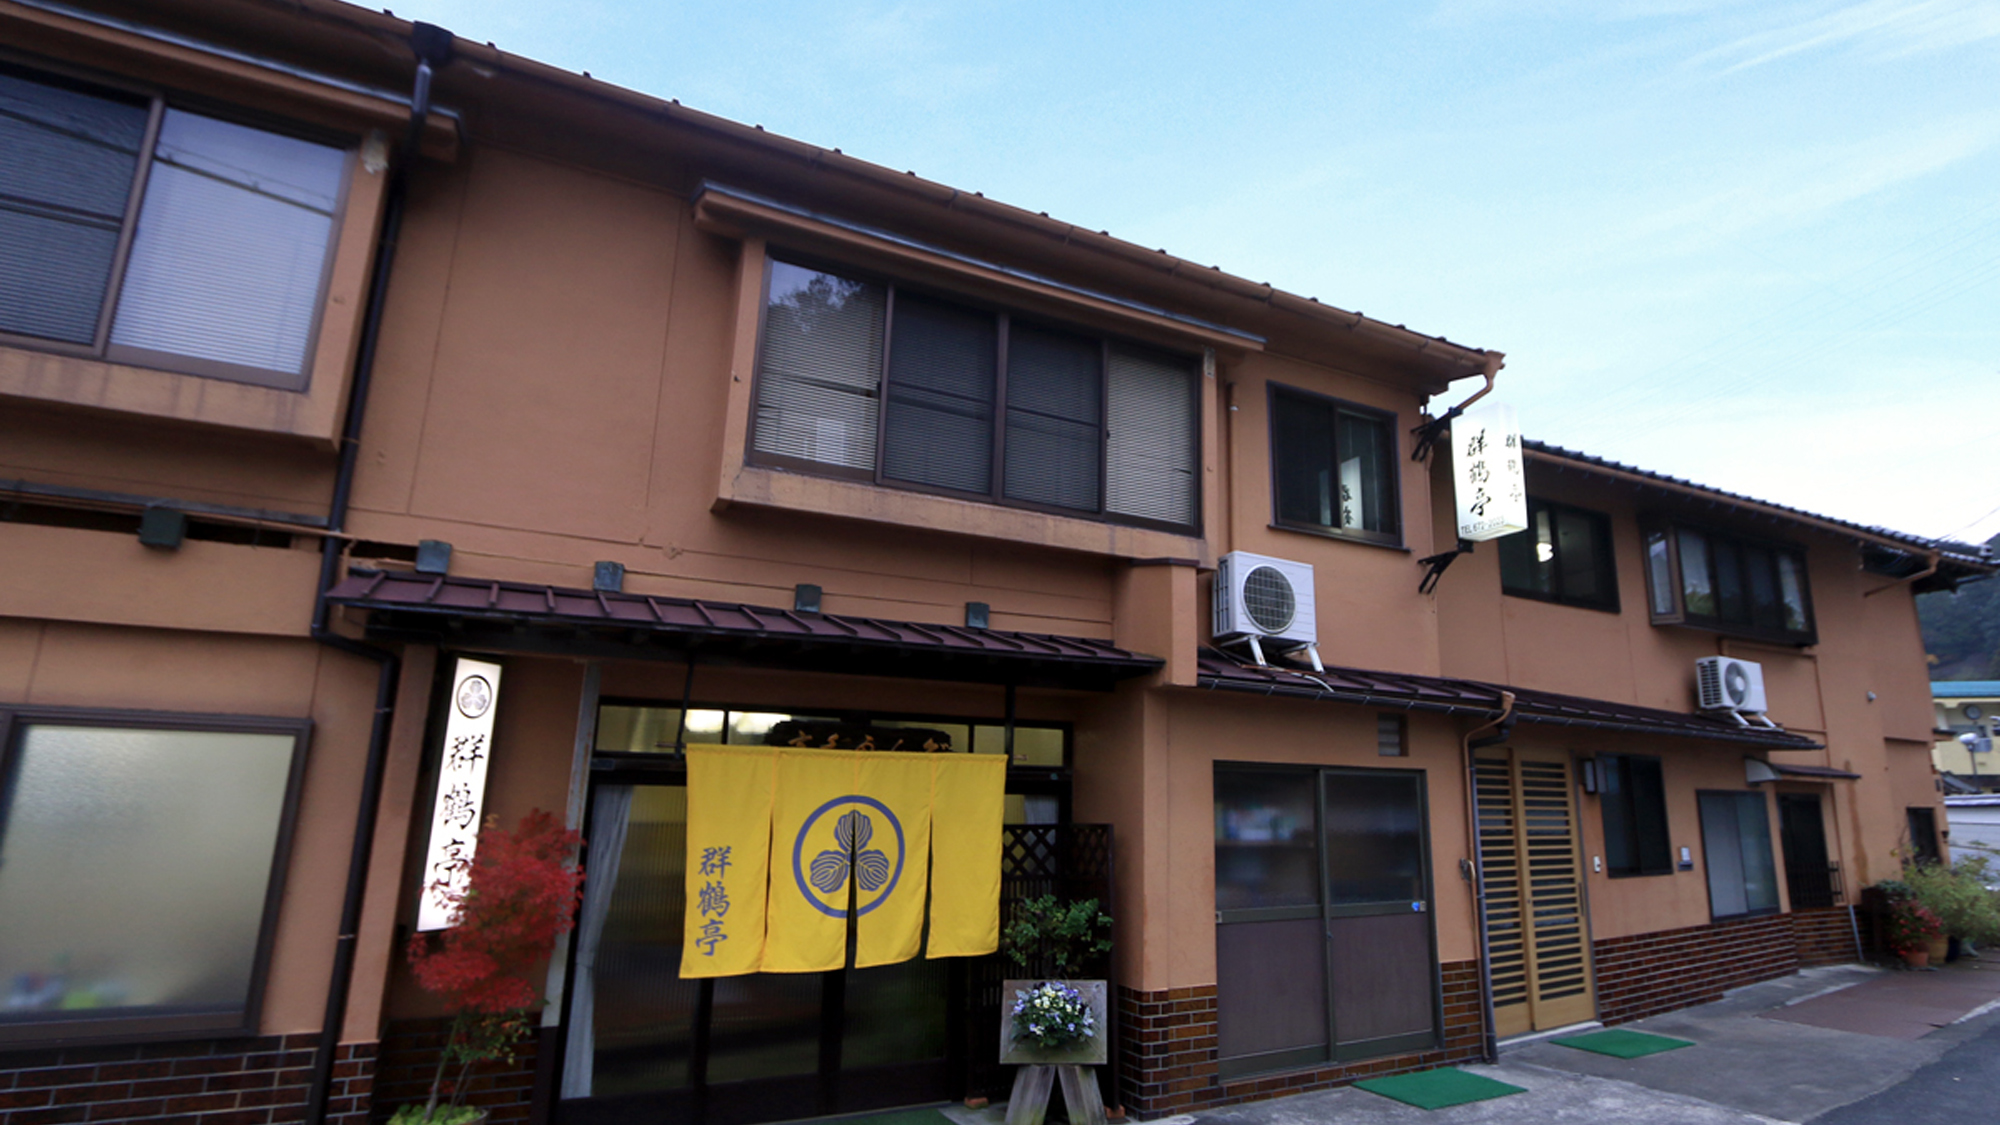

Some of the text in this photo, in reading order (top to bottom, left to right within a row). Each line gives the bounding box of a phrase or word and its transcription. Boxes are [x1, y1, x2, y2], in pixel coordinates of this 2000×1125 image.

[1467, 428, 1491, 516] 群鶴亭
[434, 733, 486, 886] 群鶴亭
[695, 845, 732, 956] 群鶴亭
